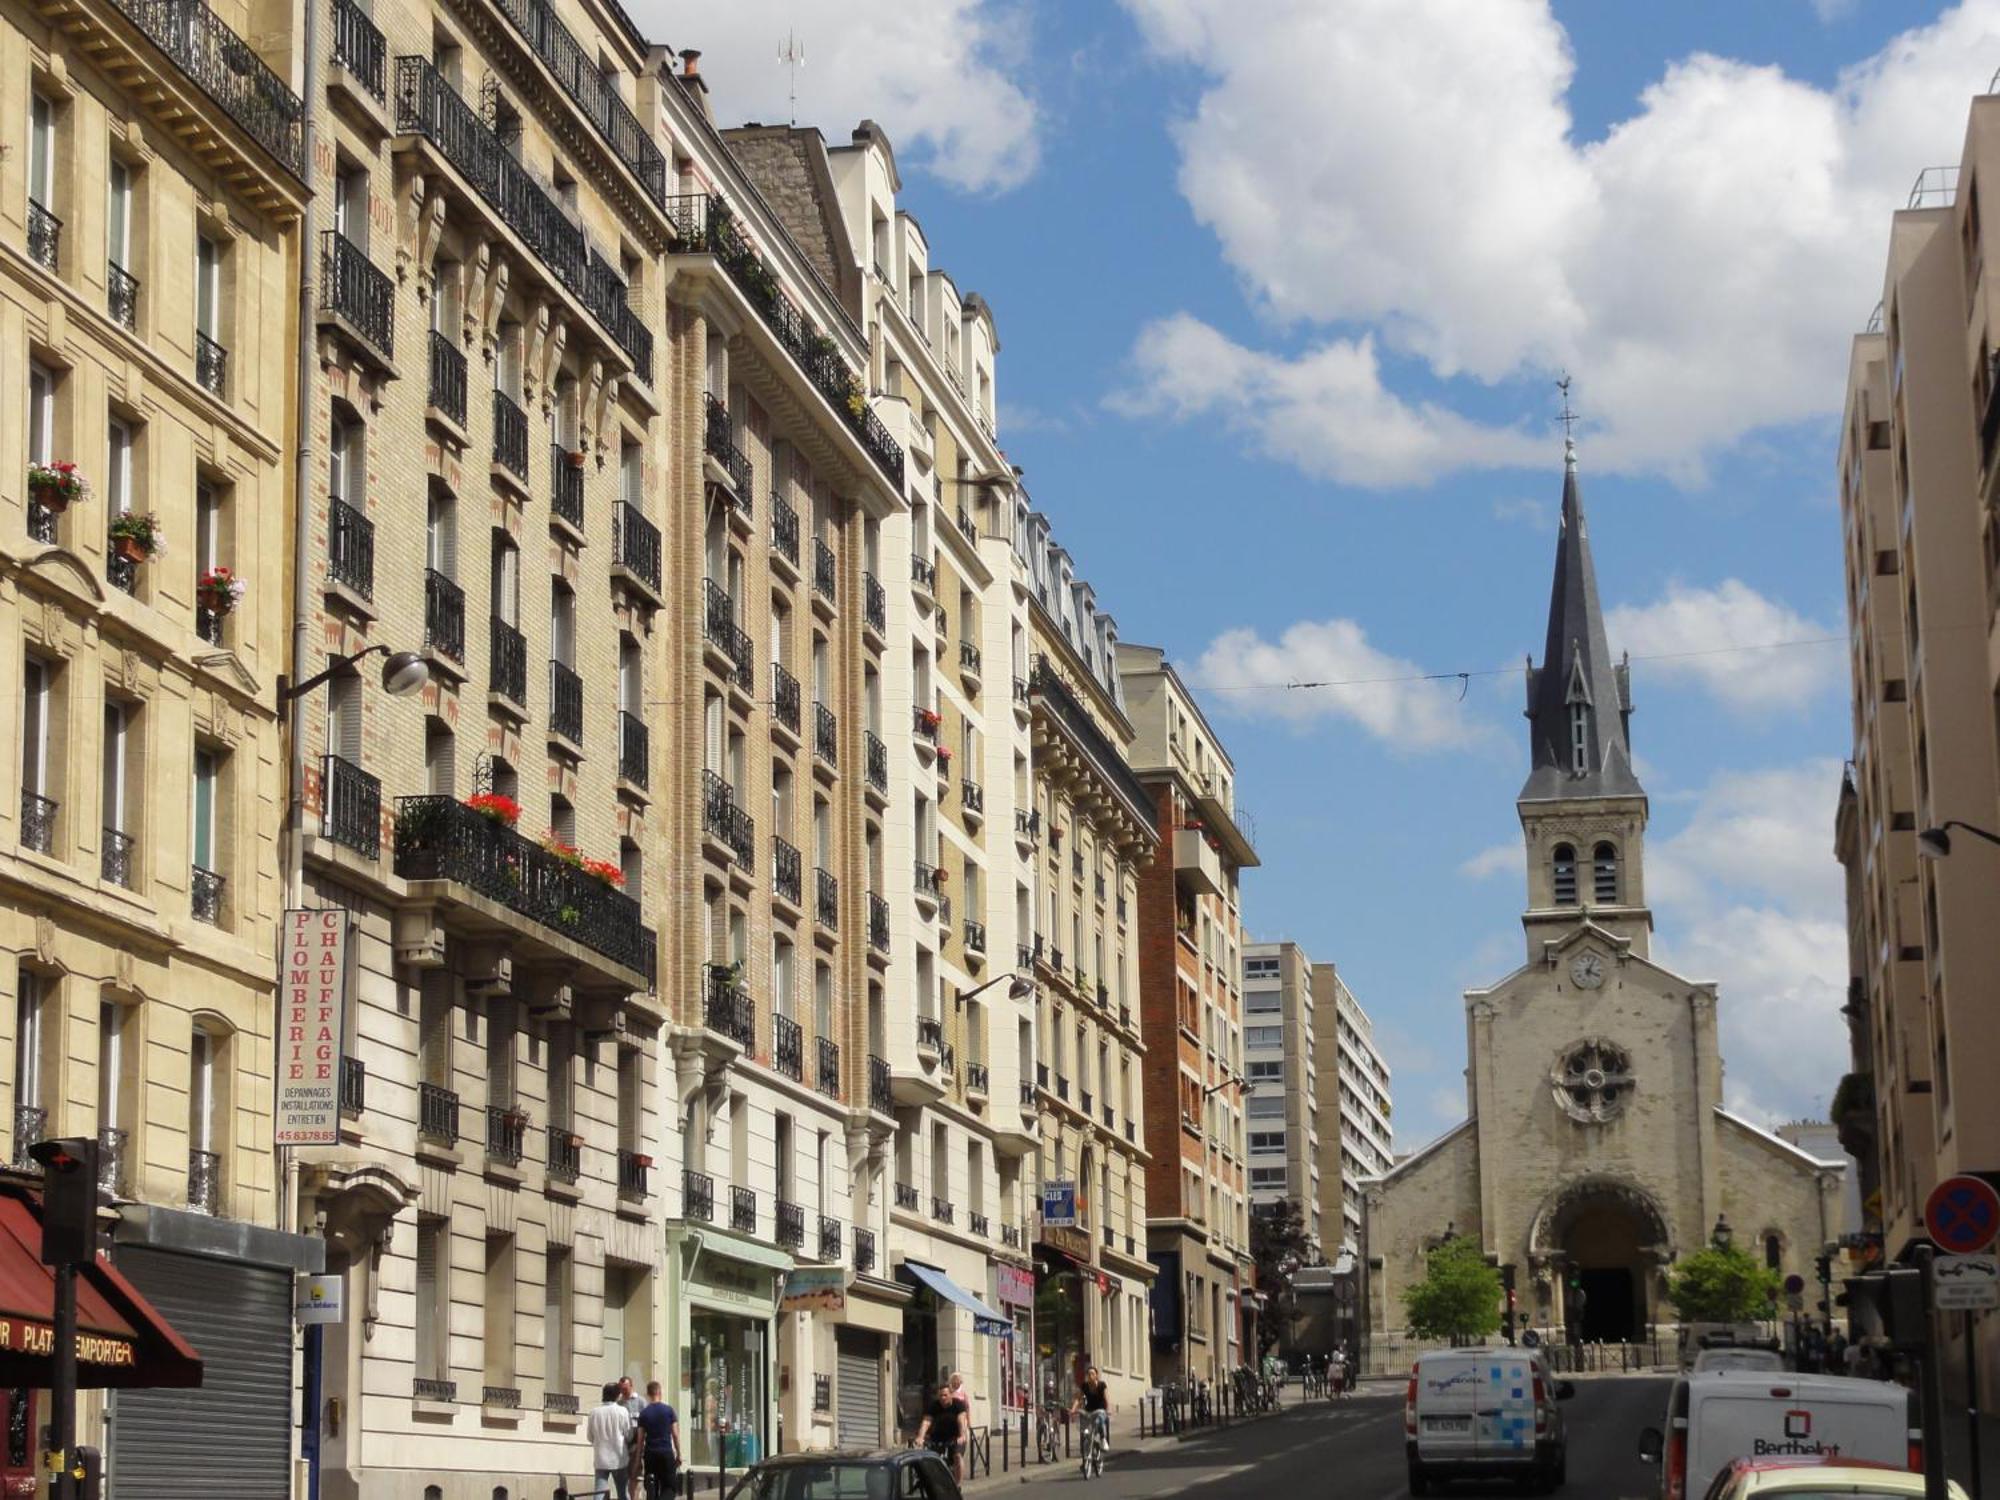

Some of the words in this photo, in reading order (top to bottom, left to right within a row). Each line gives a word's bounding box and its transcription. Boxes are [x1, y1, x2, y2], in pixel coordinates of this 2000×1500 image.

[289, 913, 310, 1079] PLOMBERIE
[316, 913, 337, 1079] CHAUFFAGE
[281, 1100, 333, 1110] INSTALLATIONS
[287, 1114, 326, 1125] ENTRETIEN
